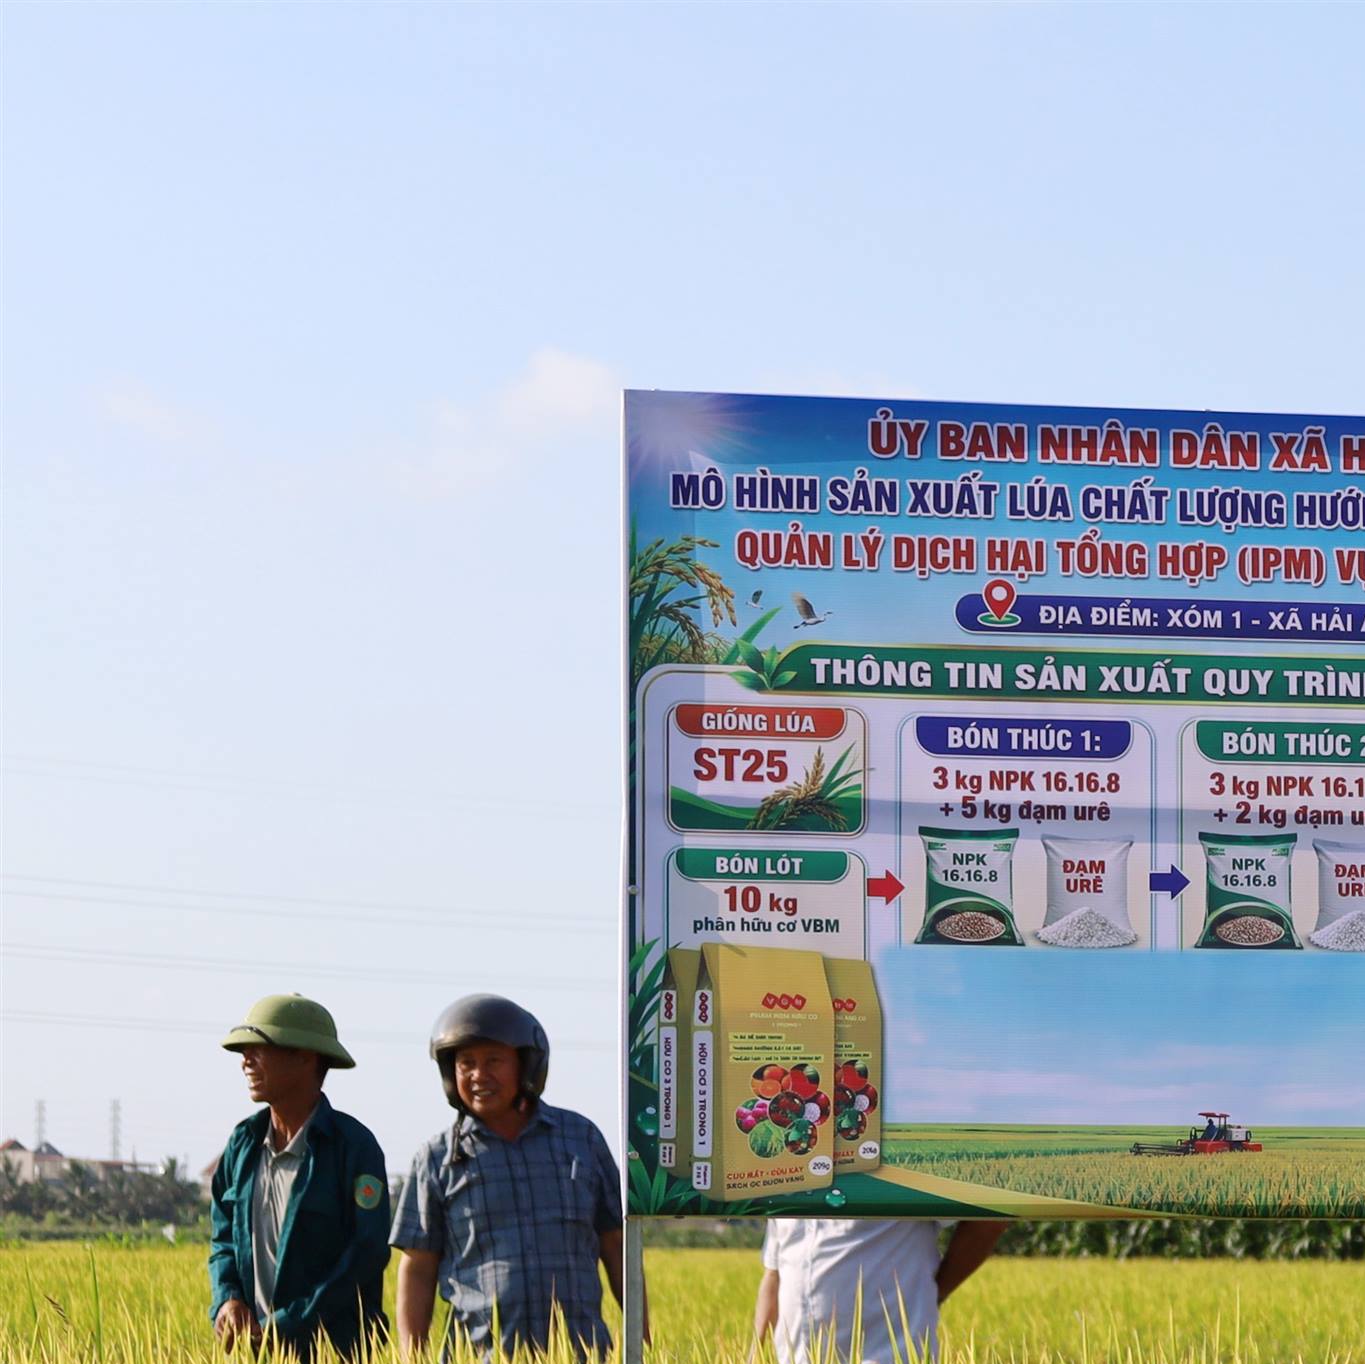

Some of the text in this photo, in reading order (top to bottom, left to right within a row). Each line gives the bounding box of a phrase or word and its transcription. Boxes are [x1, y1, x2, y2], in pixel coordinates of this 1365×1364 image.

[871, 408, 926, 458] ỦY
[940, 422, 1025, 460] BAN
[1041, 420, 1158, 464] NHÂN
[1172, 425, 1257, 468] DÂN
[1271, 427, 1329, 470] XÃ
[672, 469, 724, 508] MÔ
[735, 470, 817, 511] HÌNH
[829, 469, 898, 513] SẢN
[908, 471, 998, 516] XUẤT
[1009, 477, 1071, 520] LÚA
[1082, 477, 1168, 522] CHẤT
[1179, 489, 1284, 530] LƯỢNG
[736, 523, 831, 569] QUẢN
[844, 527, 883, 569] LÝ
[895, 538, 974, 577] DỊCH
[988, 540, 1044, 580] HẠI
[1057, 530, 1148, 576] TỔNG
[1158, 544, 1227, 585] HỢP
[1238, 547, 1325, 586] (IPM)
[1039, 605, 1083, 630] ĐỊA
[1090, 601, 1159, 628] ĐIỂM:
[1167, 603, 1223, 629] XÓM
[1232, 610, 1241, 629] 1
[1269, 608, 1301, 631] XÃ
[1312, 605, 1355, 632] HẢI
[811, 655, 932, 688] THÔNG
[944, 662, 1002, 689] TIN
[1014, 656, 1086, 690] SẢN
[1098, 657, 1191, 693] XUẤT
[1203, 668, 1273, 699] QUY
[702, 707, 815, 733] GIỐNG LÚA
[948, 722, 1101, 751] BÓN THÚC 1:
[1223, 727, 1275, 755] BÓN
[1284, 730, 1351, 756] THÚC
[693, 747, 788, 782] ST25
[933, 766, 1120, 794] 3 kg NPK 16.16.8
[1208, 772, 1225, 796] 3
[1232, 776, 1259, 799] kg
[1266, 776, 1314, 797] NPK
[961, 796, 977, 819] 5
[984, 800, 1011, 823] kg
[1018, 801, 1066, 824] đạm
[1074, 802, 1110, 821] urê
[1235, 801, 1251, 824] 2
[1259, 805, 1286, 828] kg
[1295, 805, 1343, 828] đạm
[716, 853, 803, 874] BÓN LÓT
[952, 853, 987, 866] NPK
[1062, 860, 1105, 876] ĐẠM
[1232, 858, 1266, 871] NPK
[942, 869, 998, 882] 16.16.8
[1066, 876, 1103, 893] URÊ
[1222, 875, 1277, 887] 16.16.8
[724, 886, 797, 915] 10 kg
[693, 917, 840, 934] phân hữu cơ VBM
